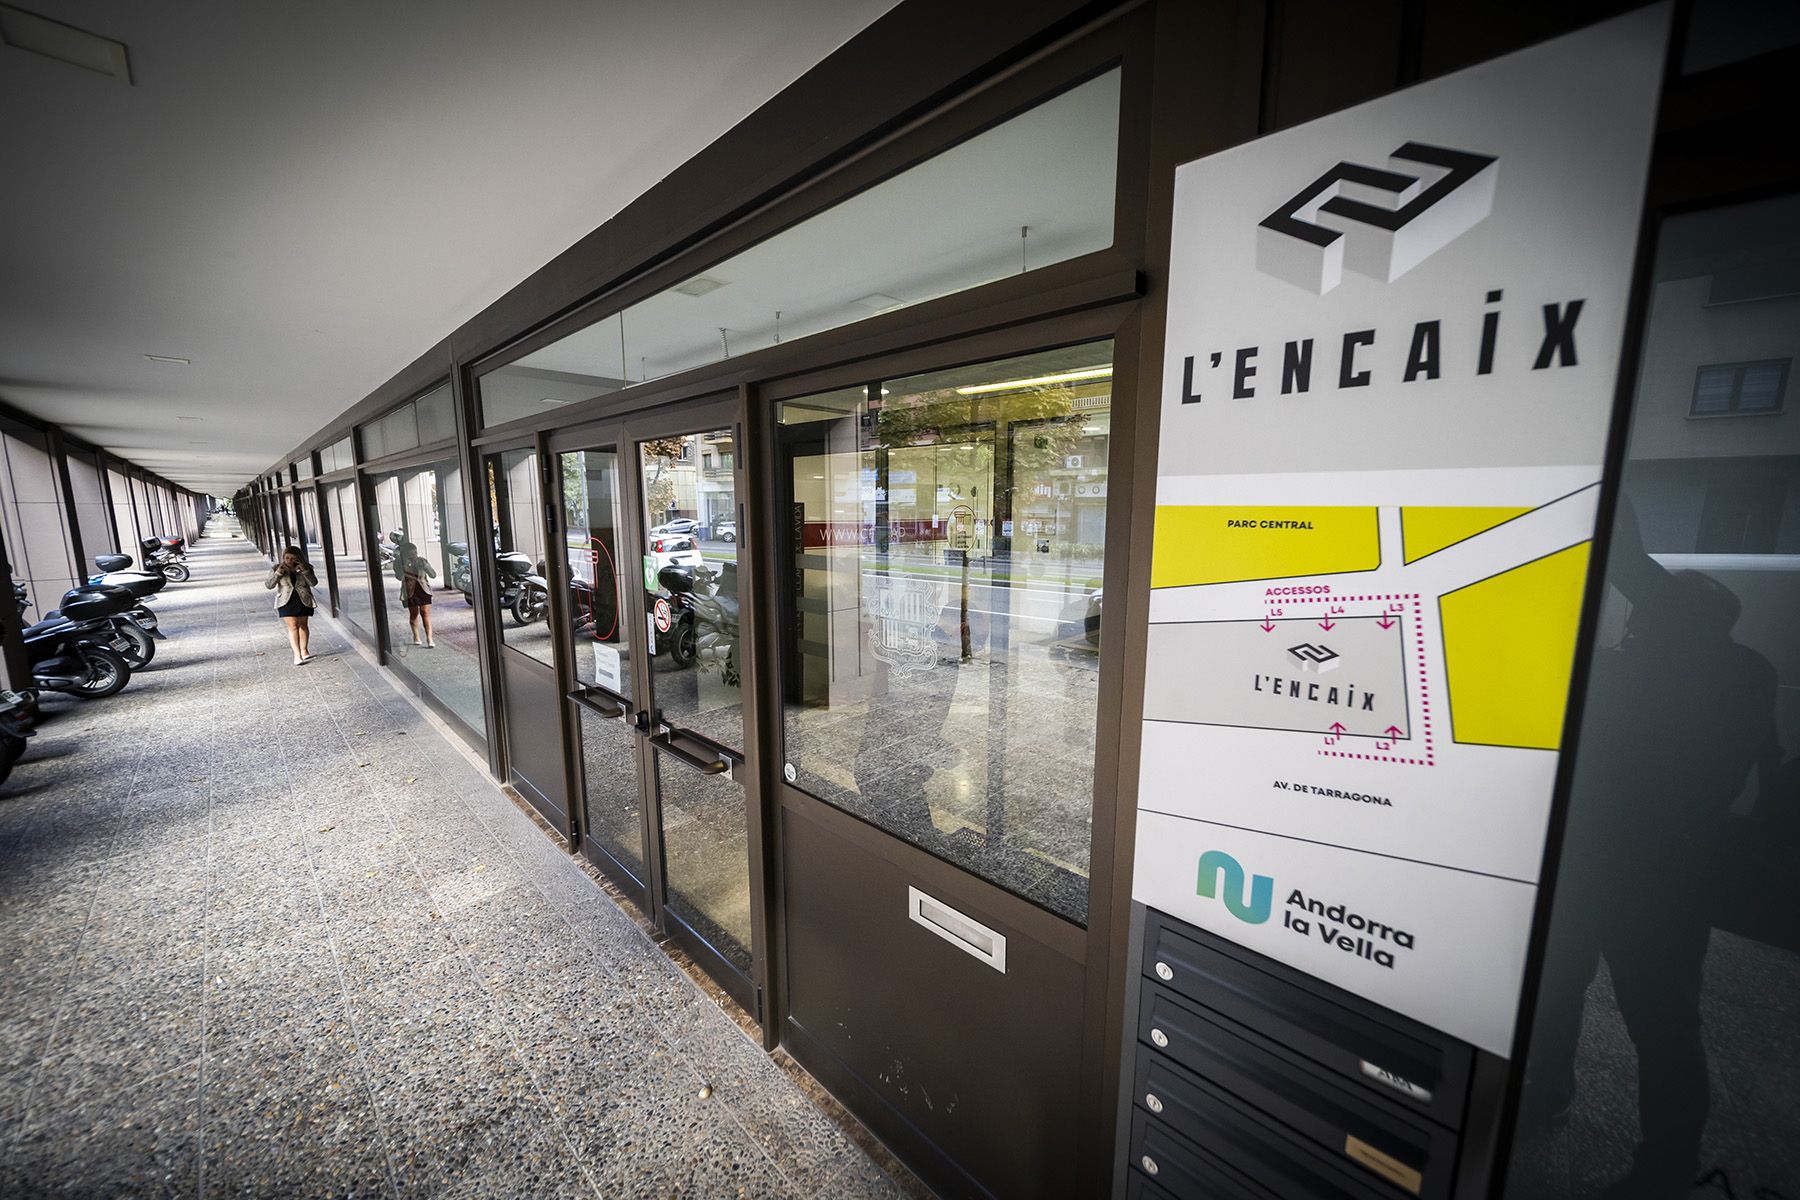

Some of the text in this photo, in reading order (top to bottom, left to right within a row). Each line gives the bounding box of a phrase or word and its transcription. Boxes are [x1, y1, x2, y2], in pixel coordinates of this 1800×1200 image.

[1227, 519, 1314, 530] PARC CENTRAL
[1265, 585, 1331, 596] ACCESSOS
[1270, 603, 1405, 617] L5 L4 L3
[1323, 736, 1390, 750] L1 L2
[1273, 780, 1393, 807] AV. DE TARRAGONA
[1285, 889, 1416, 950] Andorra
[1283, 909, 1395, 970] la Vella
